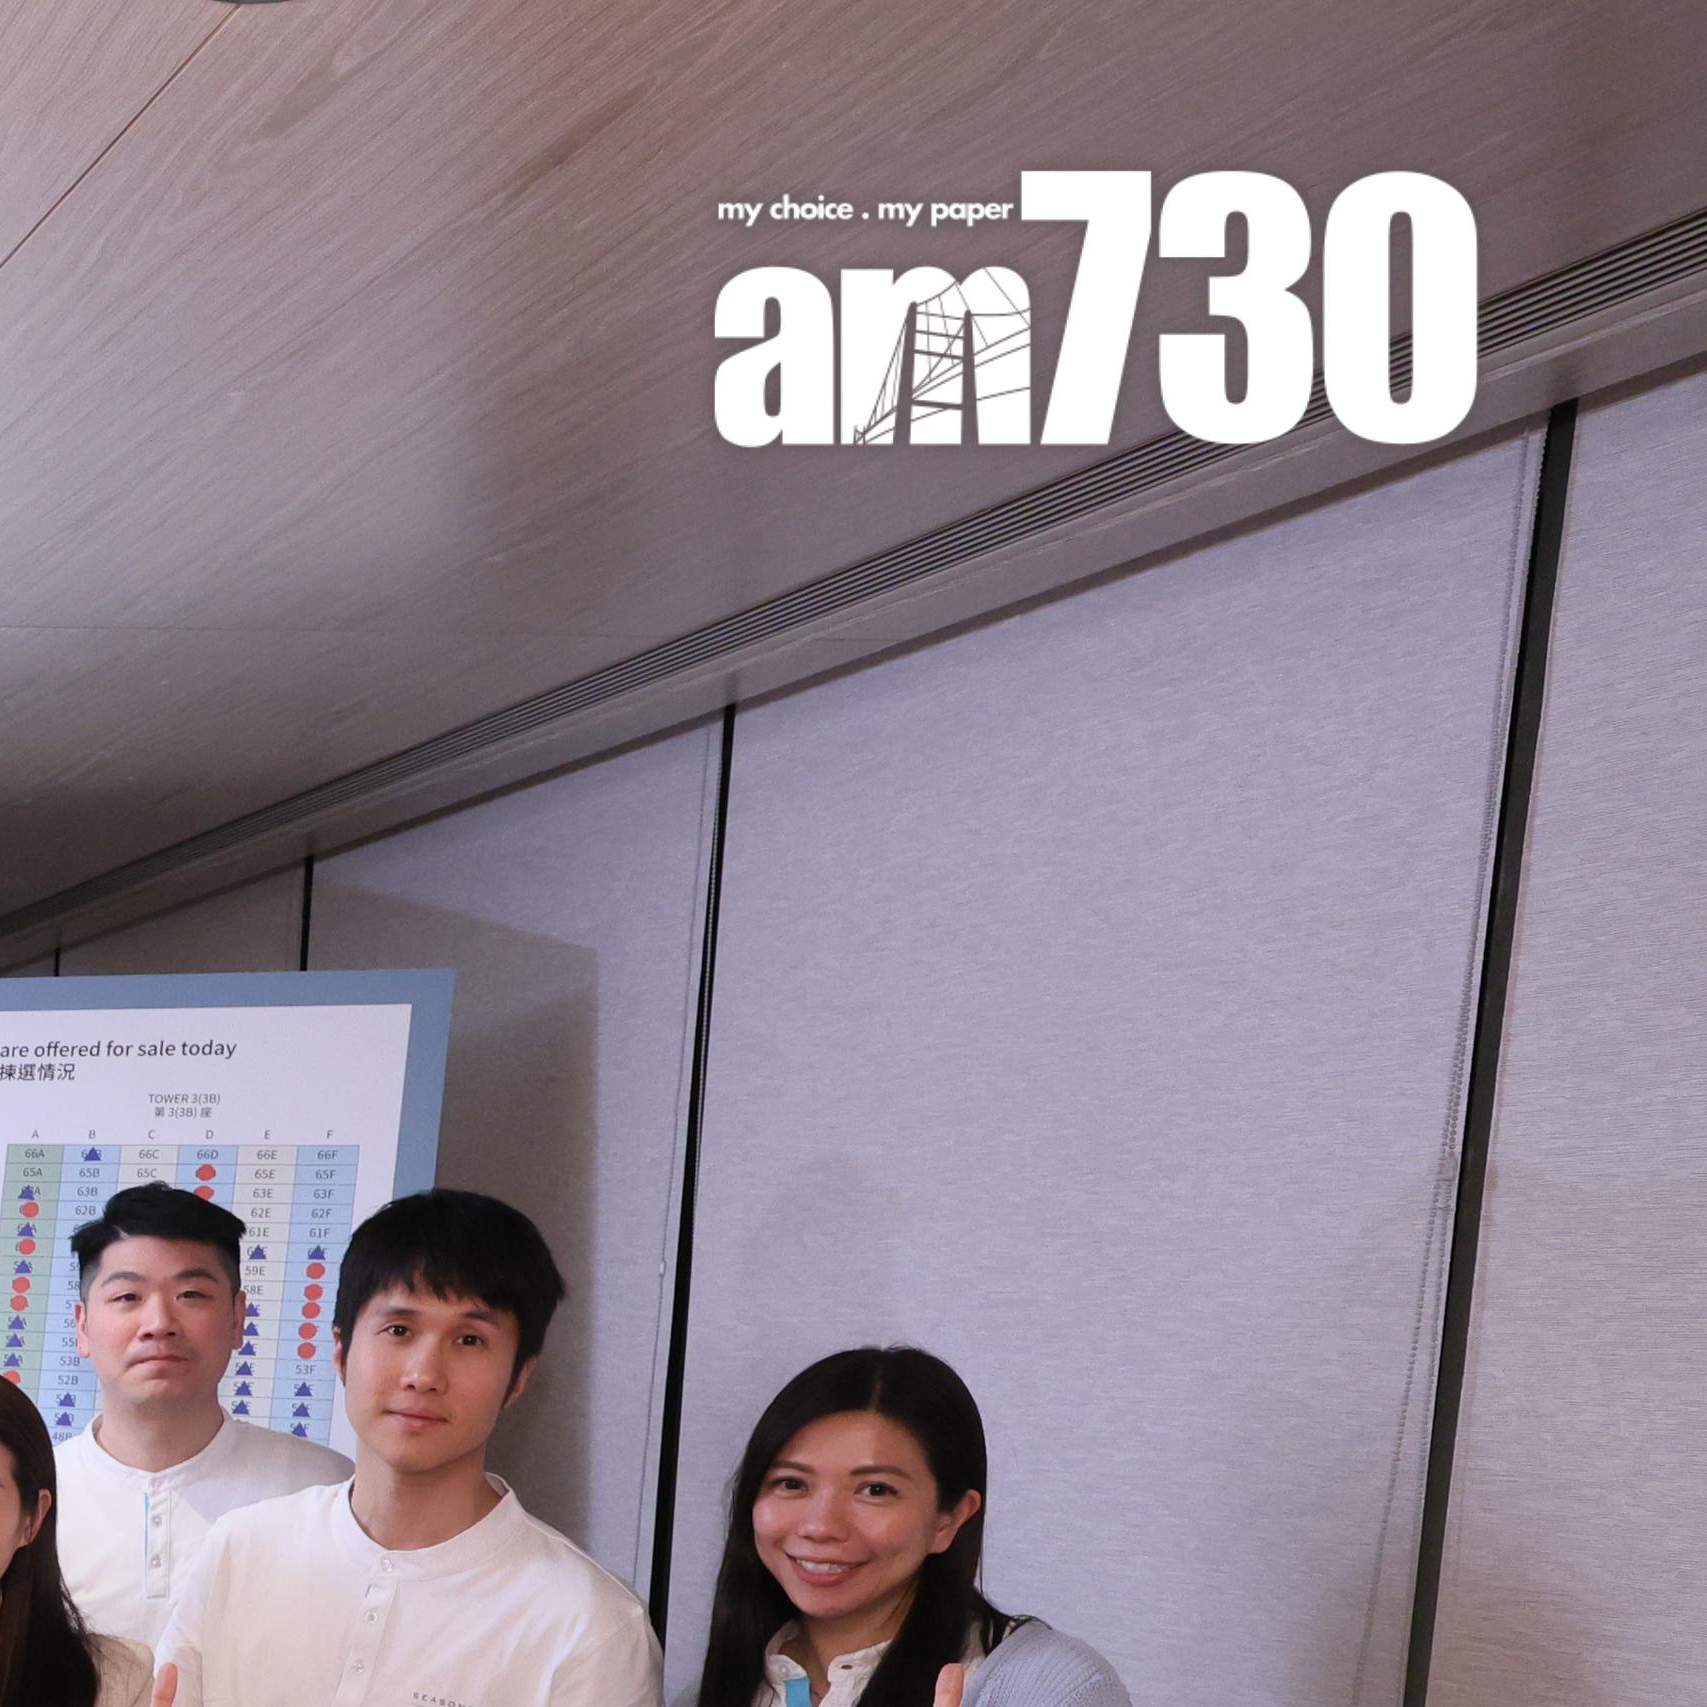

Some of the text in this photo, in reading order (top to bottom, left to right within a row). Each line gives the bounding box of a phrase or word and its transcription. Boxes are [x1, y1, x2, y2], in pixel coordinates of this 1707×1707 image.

[0, 1046, 29, 1058] are
[34, 1041, 101, 1058] offered
[107, 1041, 133, 1057] for
[138, 1040, 176, 1056] sale
[181, 1040, 237, 1060] today
[148, 1093, 221, 1105] TOWER 3(3B)
[31, 1130, 334, 1139] A B C D E F
[25, 1149, 45, 1158] 66A
[139, 1149, 159, 1159] 66C
[197, 1150, 219, 1159] 66D
[257, 1150, 277, 1160] 66E
[317, 1150, 338, 1160] 66F
[23, 1168, 43, 1177] 65A
[79, 1168, 100, 1178] 65B
[137, 1168, 157, 1178] 65C
[255, 1169, 275, 1179] 65E
[315, 1170, 336, 1179] 65F
[77, 1187, 98, 1197] 63B
[253, 1189, 273, 1198] 63E
[313, 1189, 334, 1199] 63F
[75, 1206, 96, 1216] 62B
[251, 1208, 271, 1218] 62E
[311, 1208, 332, 1218] 62F
[249, 1227, 269, 1237] 61E
[309, 1228, 330, 1238] 61F
[245, 1266, 265, 1276] 59E
[243, 1285, 263, 1295] 58E
[60, 1357, 81, 1366] 53B
[295, 1365, 316, 1375] 53F
[57, 1375, 78, 1385] 52B
